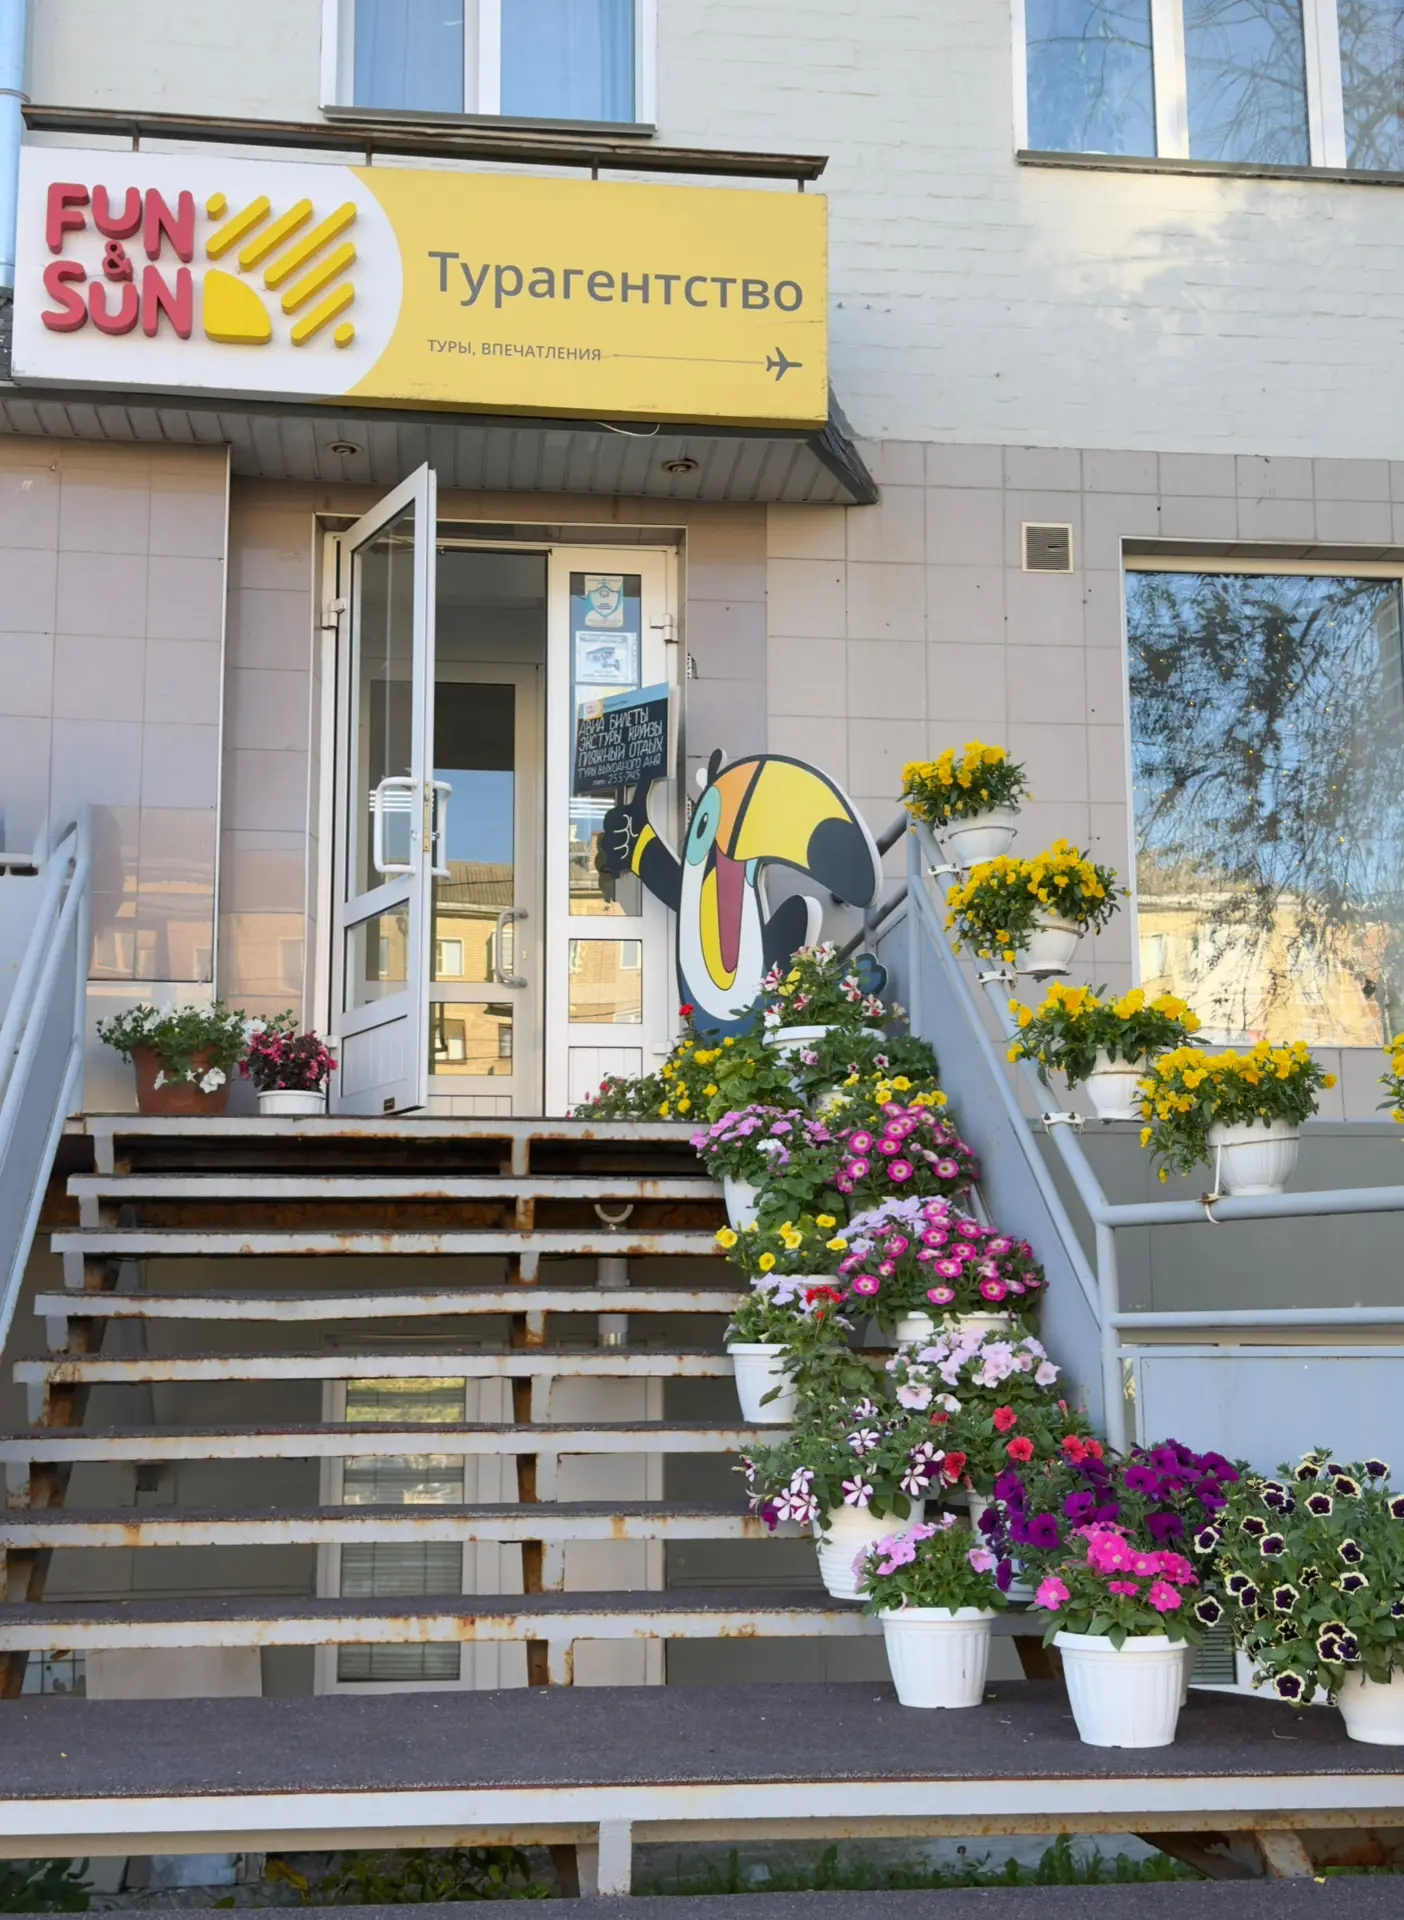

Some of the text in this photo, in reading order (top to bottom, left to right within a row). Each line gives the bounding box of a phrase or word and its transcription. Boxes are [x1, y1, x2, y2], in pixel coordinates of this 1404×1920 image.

[46, 182, 196, 263] FUN
[102, 239, 134, 283] &
[427, 250, 803, 312] Турагентство
[41, 260, 194, 340] SUN
[427, 339, 601, 361] ТУРЫ, ВПЕЧАТЛЕНИЯ
[579, 717, 605, 737] АВИА
[609, 706, 649, 730] БИЛЕТЫ
[628, 720, 663, 742] КРУИЗЫ
[577, 753, 661, 778] ТУРЫ ВЫХОДНОГО ДНЯ
[578, 736, 664, 767] ПЛЯЖНЫЙ ОТДЫХ
